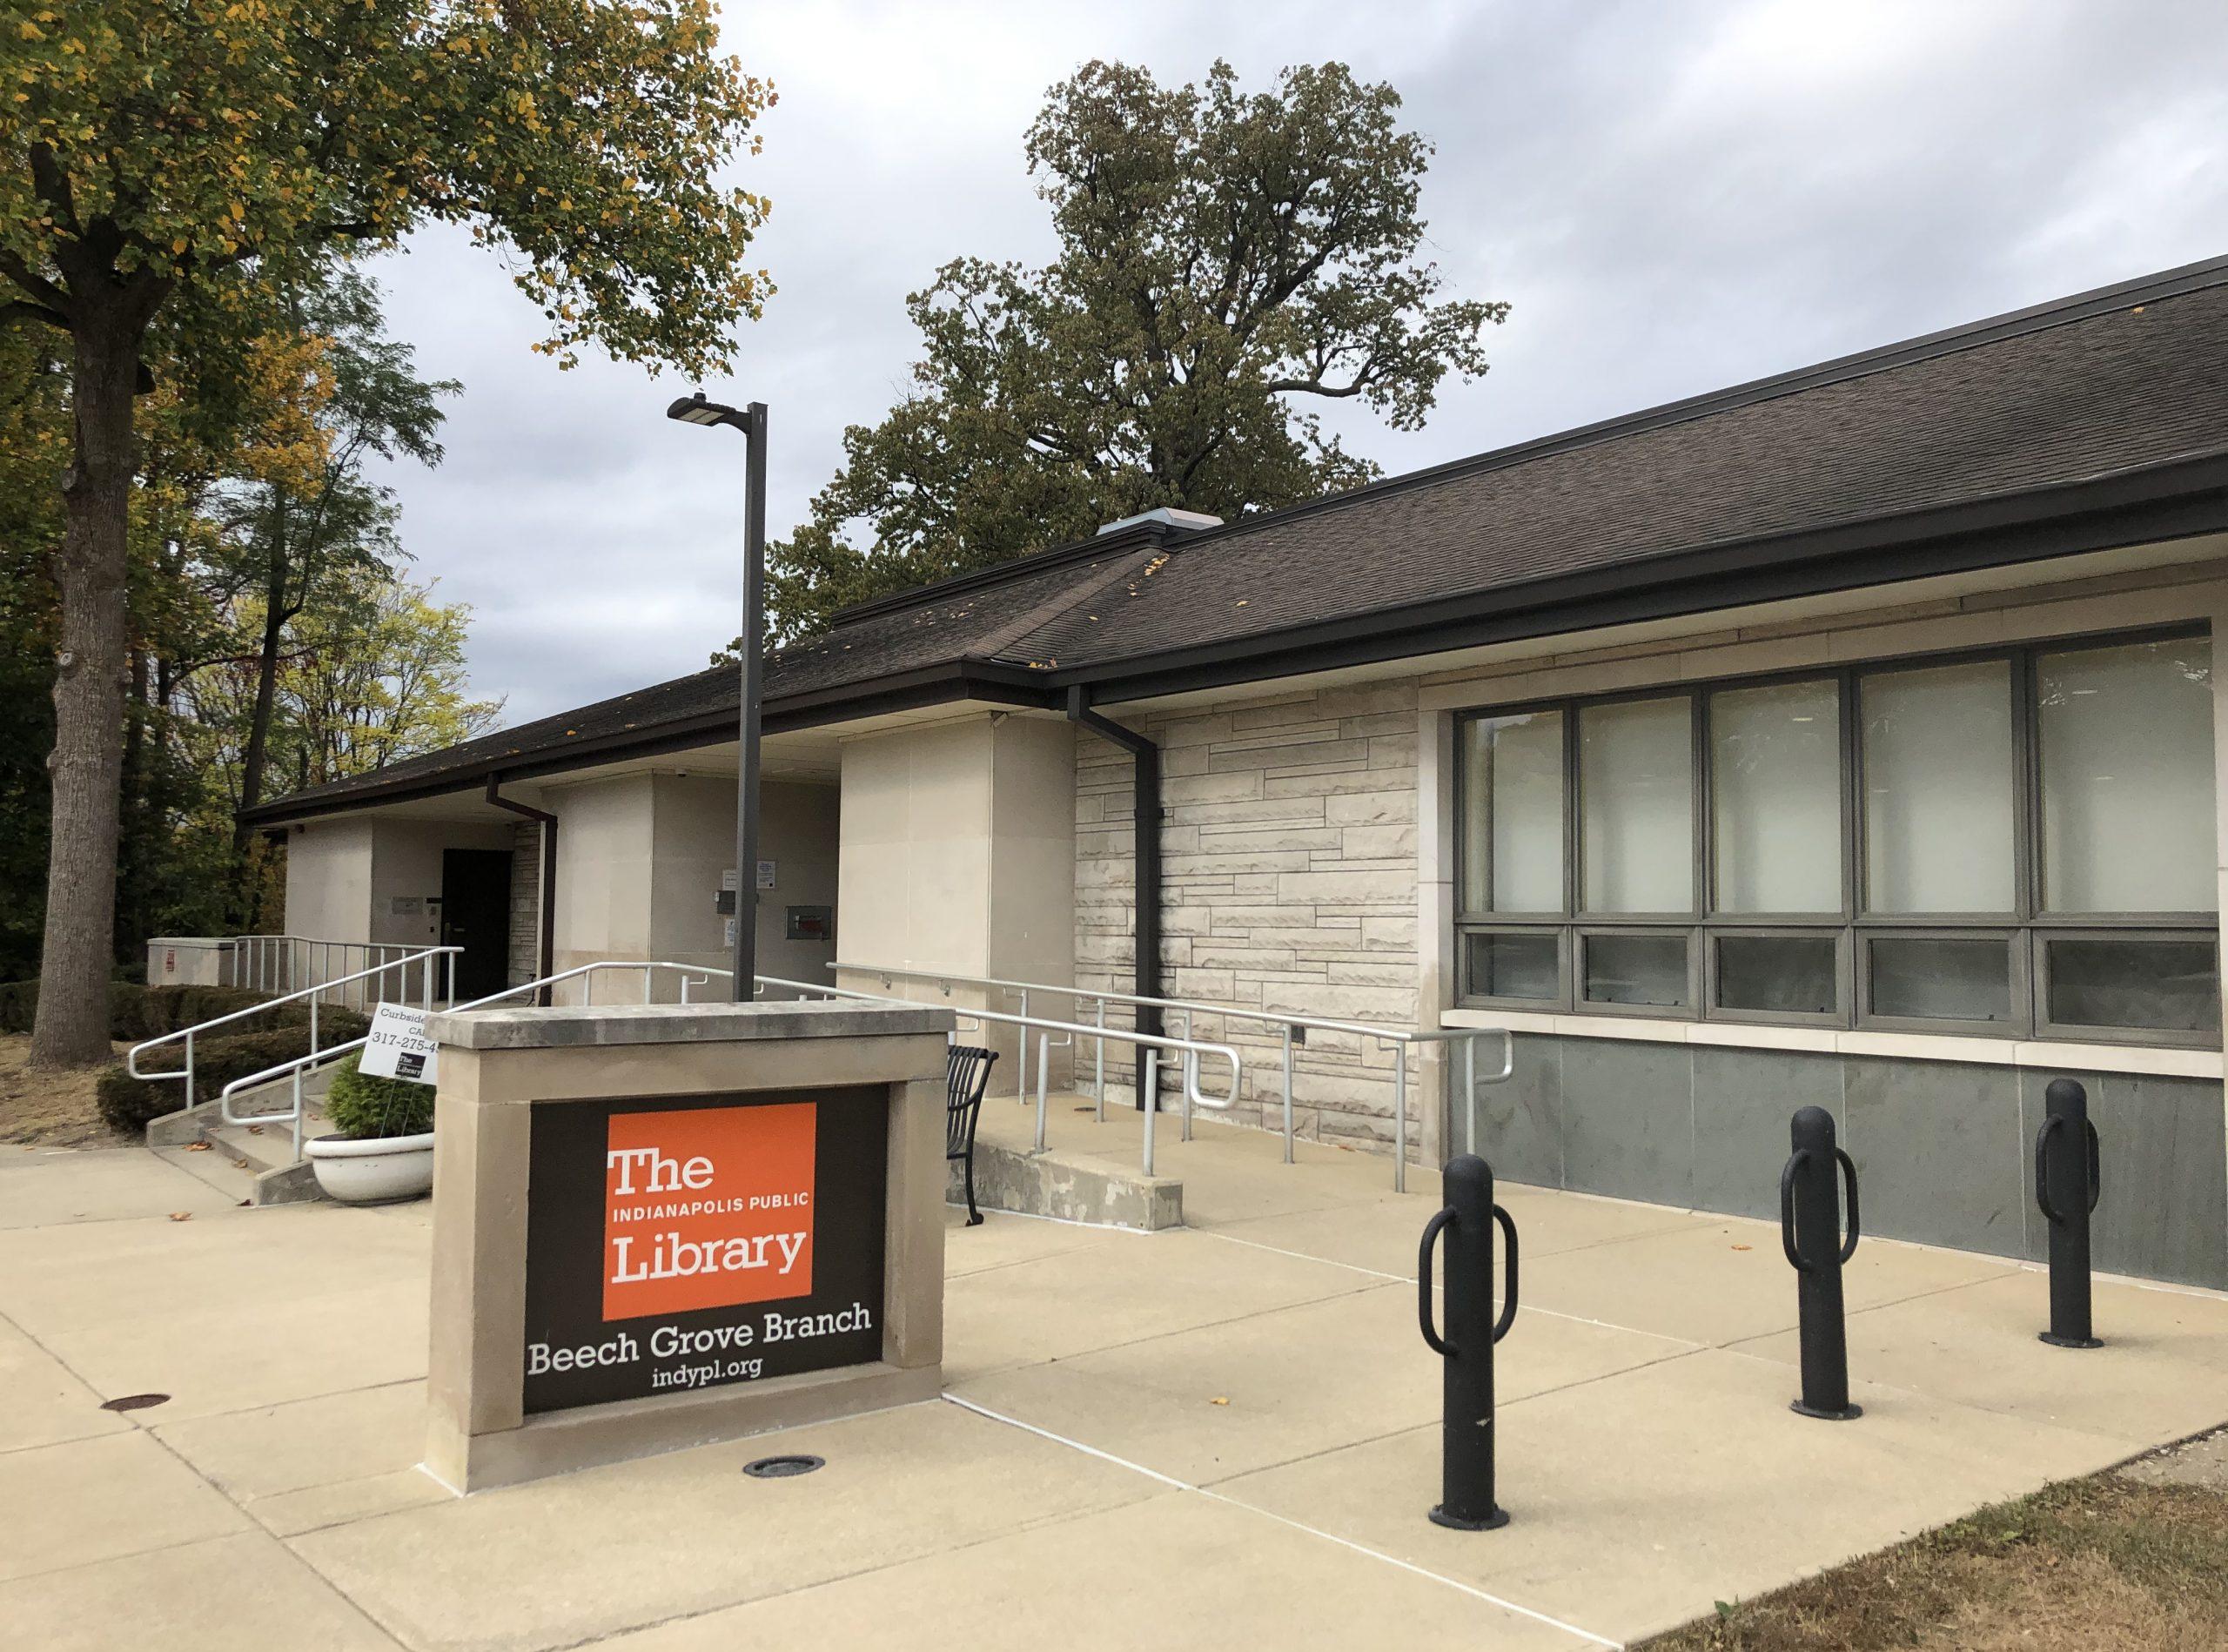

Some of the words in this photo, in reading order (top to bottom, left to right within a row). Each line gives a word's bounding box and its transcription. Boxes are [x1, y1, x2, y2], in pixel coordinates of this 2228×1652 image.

[607, 1147, 714, 1195] The
[613, 1198, 743, 1223] INDIANAPOLIS
[749, 1192, 809, 1211] PUBLIC
[611, 1232, 807, 1284] Library
[527, 1333, 640, 1376] Beech
[650, 1324, 754, 1358] Grove
[762, 1302, 872, 1344] Branch
[652, 1358, 763, 1388] indypl.org
